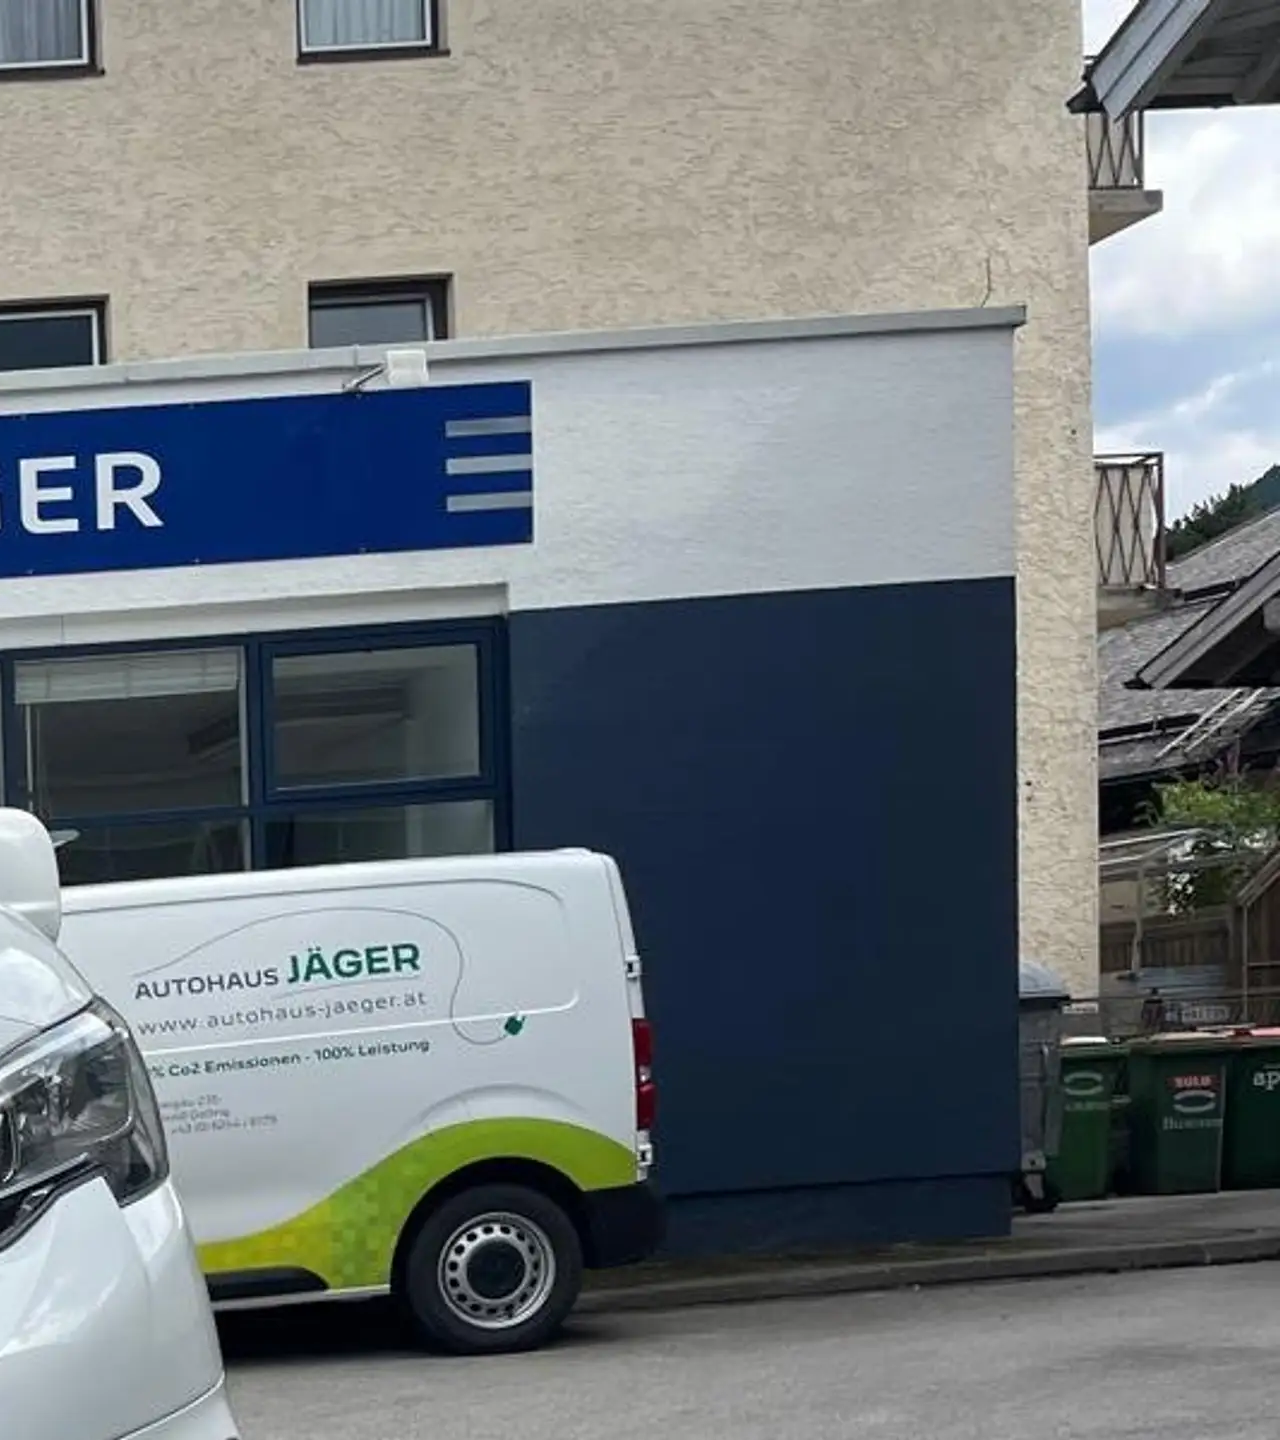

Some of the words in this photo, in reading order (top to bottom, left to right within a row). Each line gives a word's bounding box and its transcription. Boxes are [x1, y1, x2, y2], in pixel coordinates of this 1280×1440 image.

[135, 967, 279, 1000] AUTOHAUS
[286, 943, 421, 984] JÄGER
[137, 990, 427, 1036] www.autohaus-jaeger.at
[204, 1054, 302, 1074] Emissionen
[313, 1046, 355, 1062] 100%
[358, 1039, 431, 1057] Leistung
